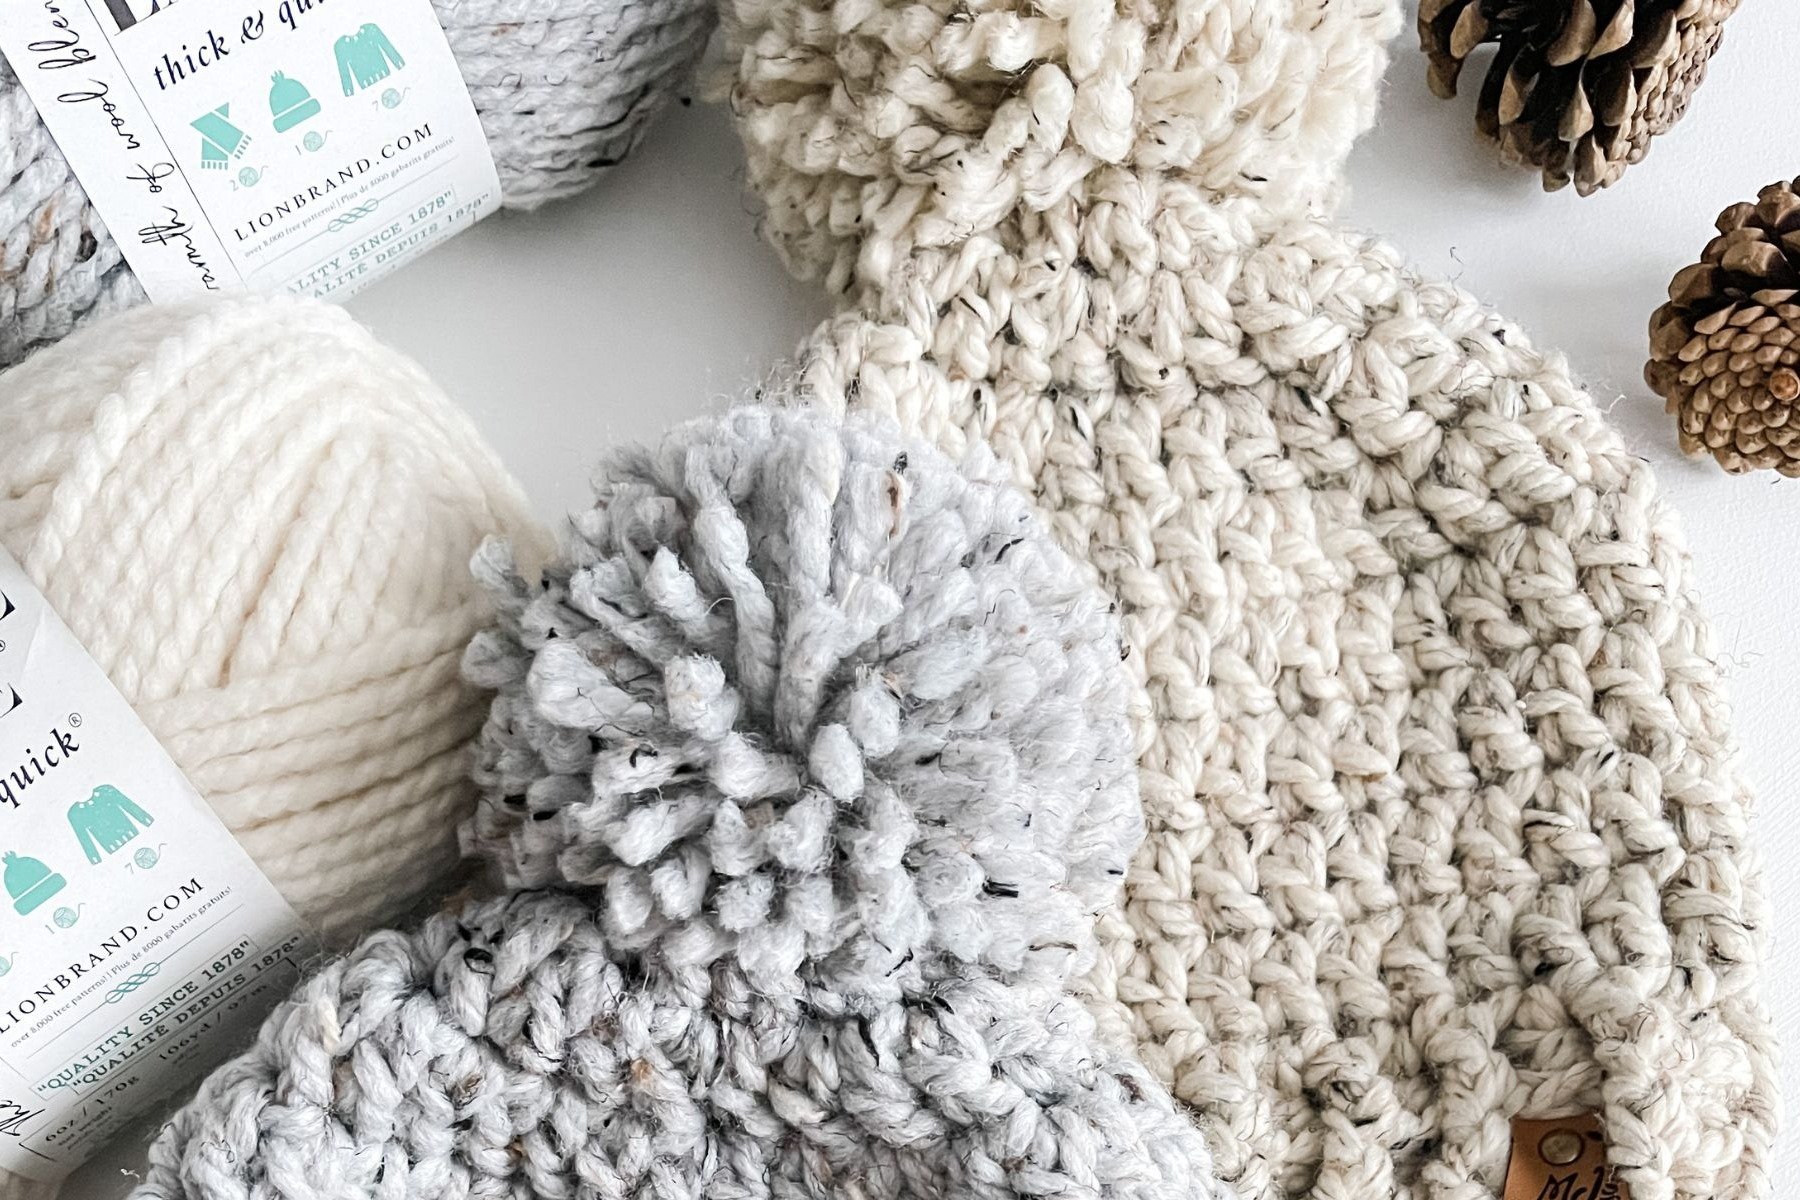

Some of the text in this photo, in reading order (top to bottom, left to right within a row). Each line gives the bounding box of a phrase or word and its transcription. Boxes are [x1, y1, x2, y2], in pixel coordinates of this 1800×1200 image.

[153, 0, 324, 90] thick & qu
[57, 78, 141, 150] wool
[126, 162, 175, 193] of
[229, 179, 239, 191] 2
[234, 123, 433, 241] LIONBRAND.COM
[138, 206, 220, 290] armth
[350, 222, 402, 261] SINCE
[124, 862, 134, 875] 7
[11, 1032, 30, 1048] over
[53, 1002, 71, 1018] free
[111, 958, 131, 975] Plus
[132, 951, 142, 962] de
[37, 1025, 134, 1092] "QUALITY
[139, 980, 199, 1027] SINCE
[201, 940, 250, 982] 1878"
[174, 973, 247, 1025] DEPUIS
